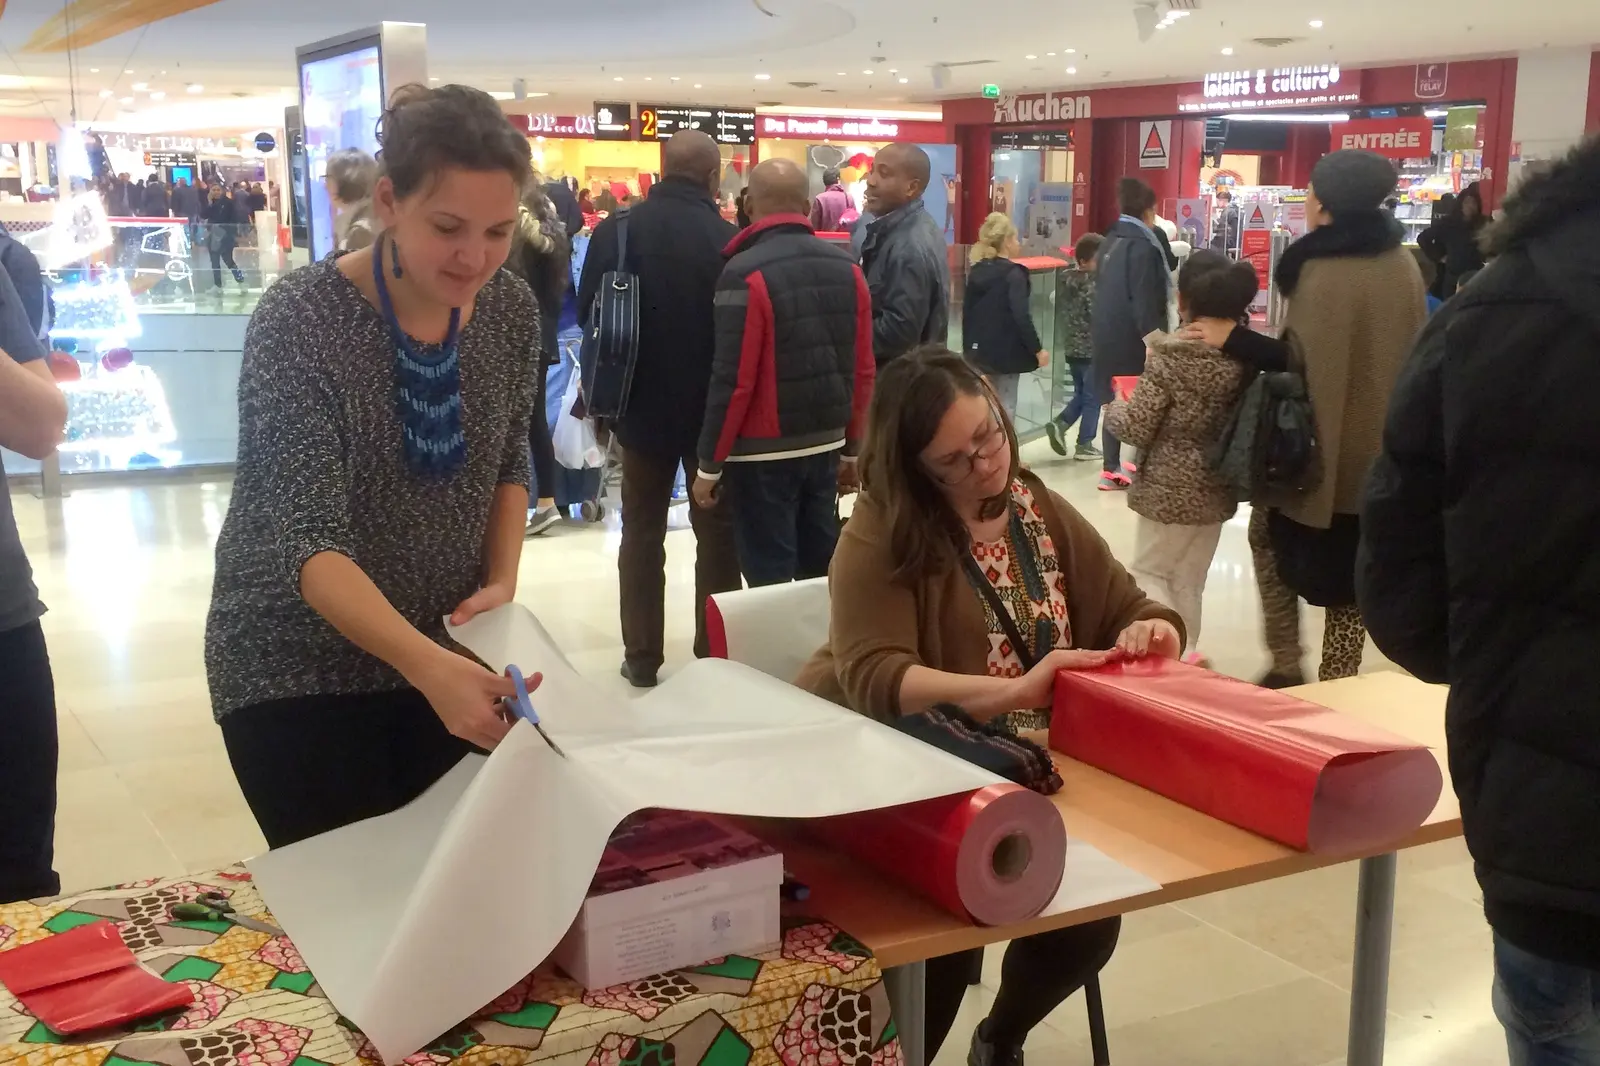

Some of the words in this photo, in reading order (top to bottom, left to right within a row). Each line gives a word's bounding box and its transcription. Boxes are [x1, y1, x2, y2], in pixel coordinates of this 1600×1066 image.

[1204, 76, 1250, 97] loisirs
[1272, 71, 1329, 93] culture
[993, 92, 1091, 123] Auchan
[1265, 97, 1294, 107] spectacles
[1295, 96, 1309, 105] pour
[1311, 95, 1328, 103] petits
[1338, 93, 1358, 102] grands
[641, 110, 655, 136] 2
[1341, 128, 1421, 150] ENTRÉE
